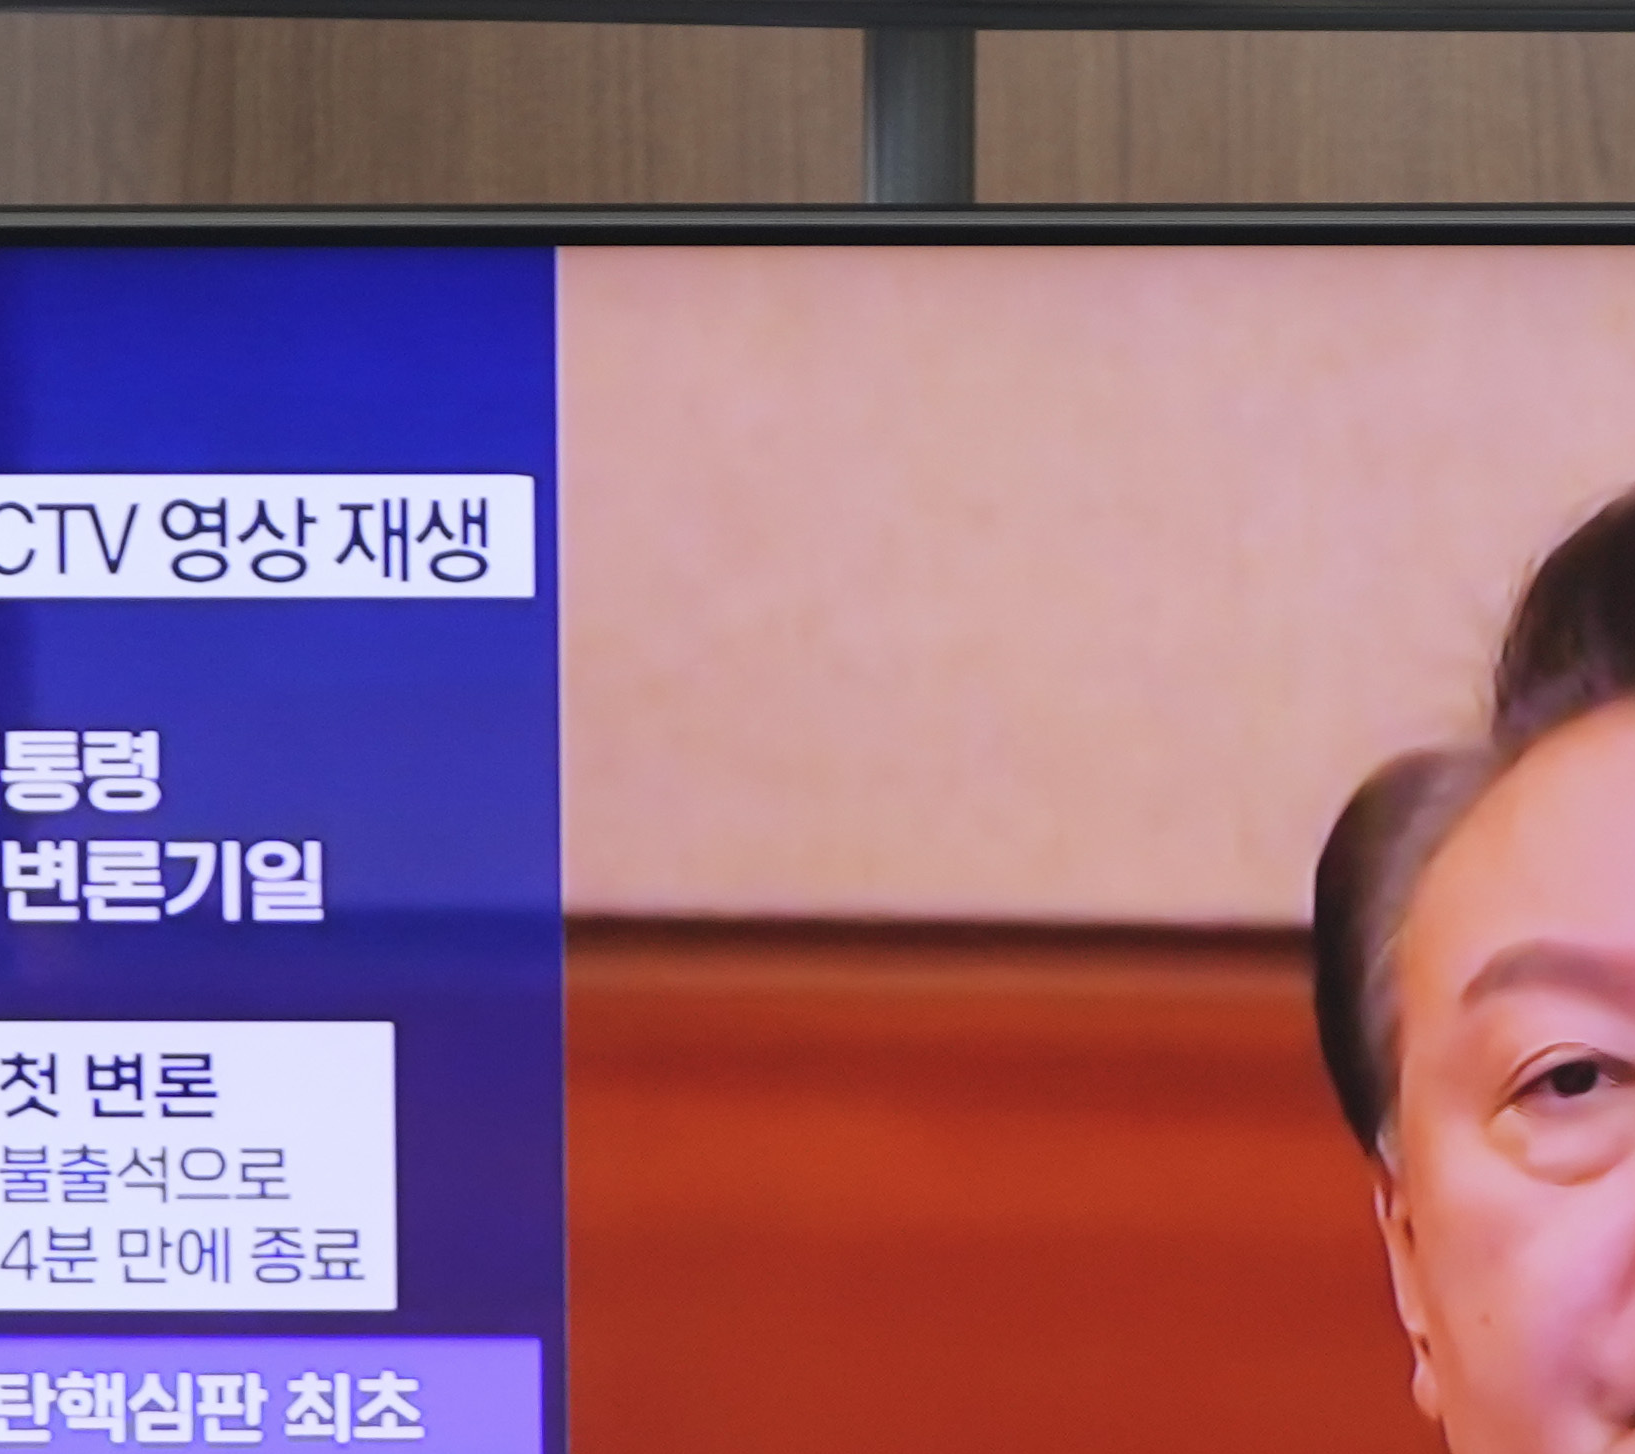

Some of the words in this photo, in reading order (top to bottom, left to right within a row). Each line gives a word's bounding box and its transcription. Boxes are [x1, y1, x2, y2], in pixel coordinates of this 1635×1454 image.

[160, 498, 317, 583] 영상
[336, 498, 488, 583] 재생
[2, 840, 324, 922] 변론기일
[1, 1053, 58, 1117] 첫
[87, 1053, 217, 1118] 변론
[0, 1145, 289, 1203] 불출석으로
[0, 1227, 97, 1284] 4분
[119, 1228, 230, 1284] 만에
[252, 1227, 363, 1284] 종료
[284, 1370, 425, 1444] 최초
